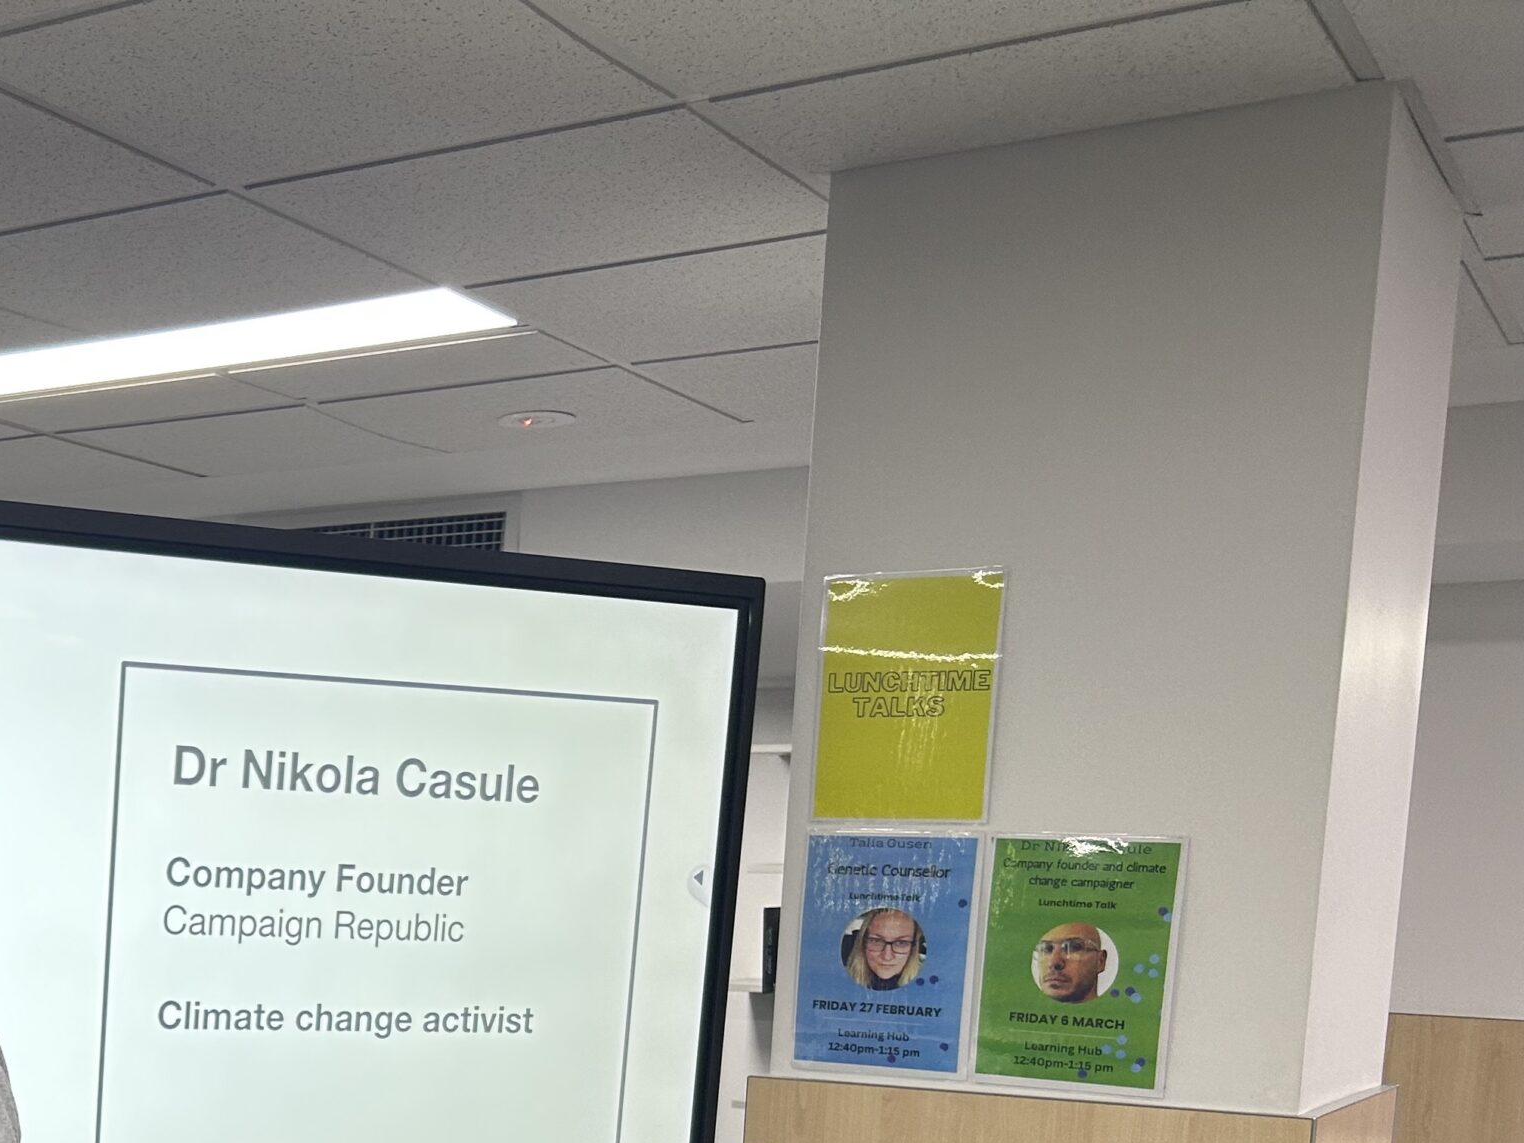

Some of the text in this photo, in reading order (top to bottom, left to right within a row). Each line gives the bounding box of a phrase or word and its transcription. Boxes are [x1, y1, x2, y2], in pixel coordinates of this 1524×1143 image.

[828, 669, 992, 694] LUNCHTIME
[852, 695, 946, 718] TALKS
[174, 745, 541, 804] Dr Nikola Casule
[1021, 840, 1042, 852] Dr
[827, 861, 951, 879] Genetic Counsellor
[1003, 857, 1168, 874] Company founder and climate
[166, 857, 469, 899] Company Founder
[1028, 875, 1135, 891] change campaigner
[1038, 898, 1117, 910] Lunchtime Talk
[162, 905, 466, 948] Campaign Republic
[812, 999, 943, 1018] FRIDAY 27 FEBRUARY
[157, 1000, 535, 1039] Climate change activist
[1008, 1011, 1126, 1031] FRIDAY 6 MARCH
[837, 1027, 911, 1042] Learning Hub
[902, 1049, 921, 1059] pm
[1024, 1040, 1103, 1057] Learning Hub
[1094, 1062, 1114, 1074] pm
